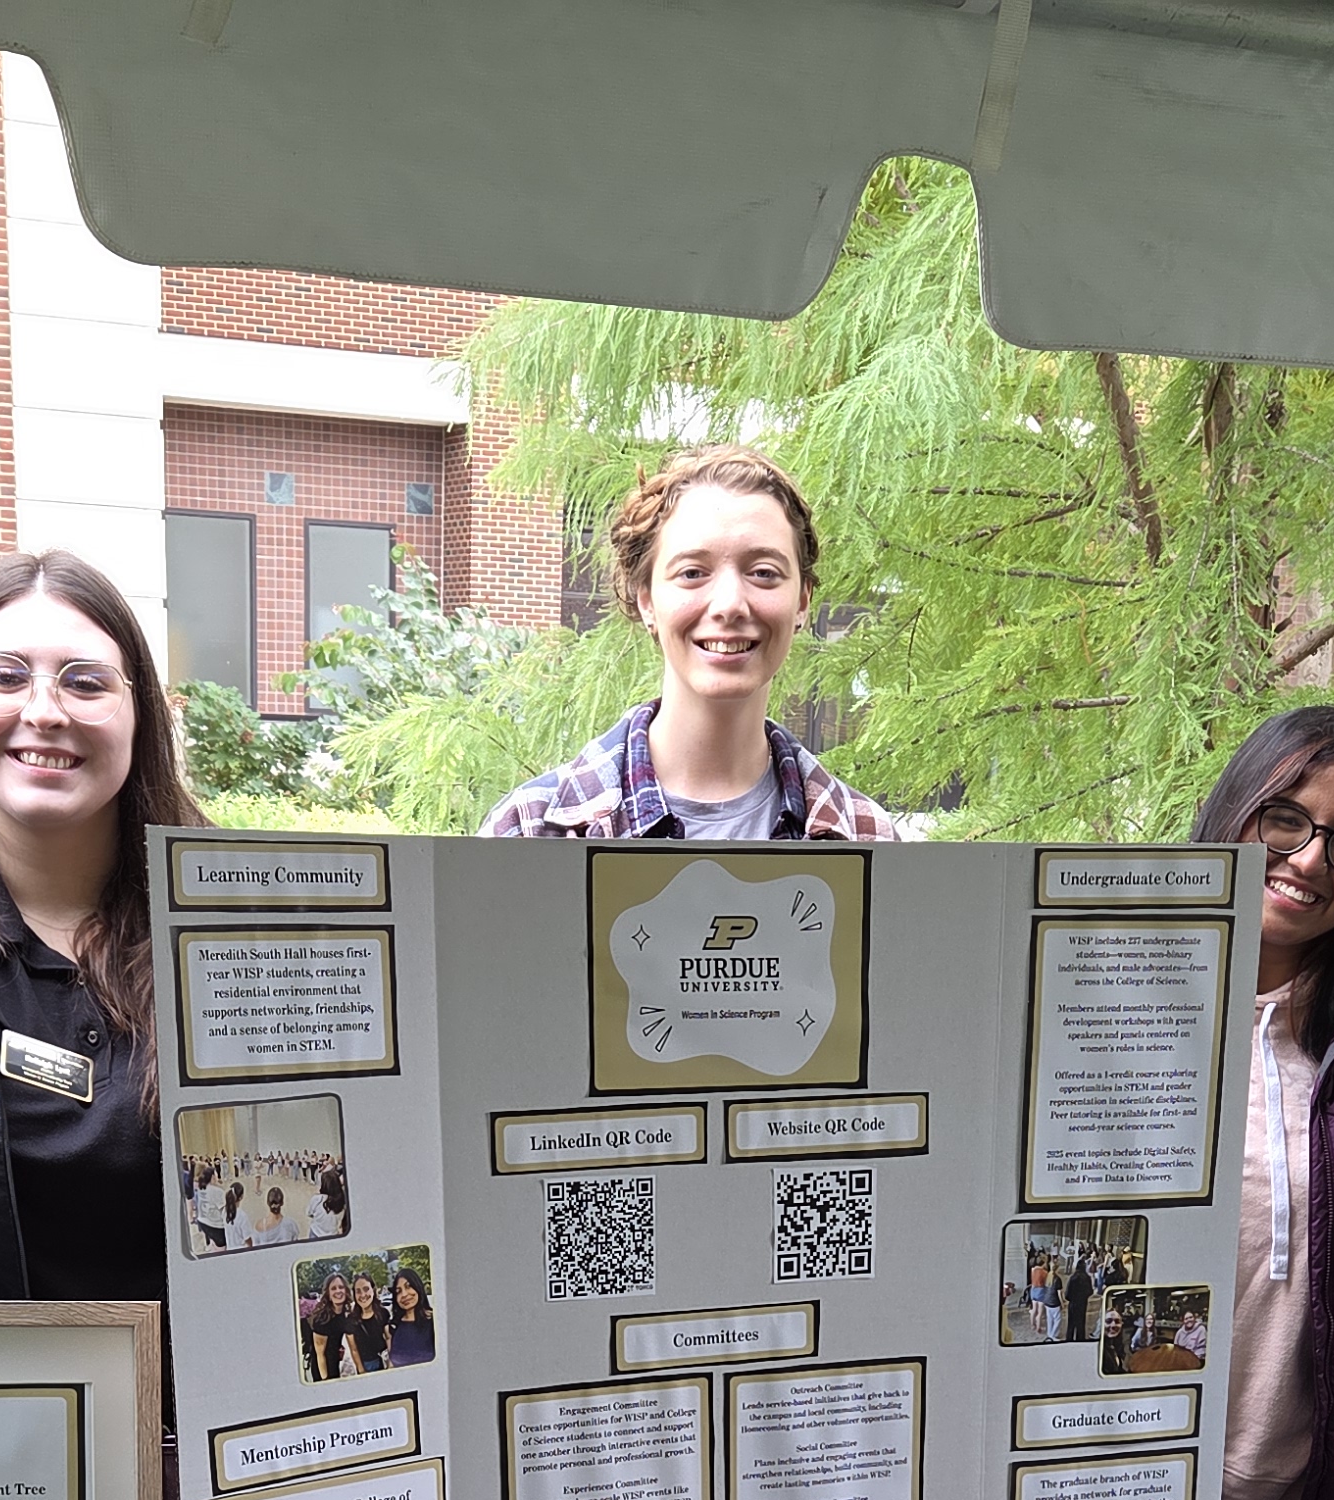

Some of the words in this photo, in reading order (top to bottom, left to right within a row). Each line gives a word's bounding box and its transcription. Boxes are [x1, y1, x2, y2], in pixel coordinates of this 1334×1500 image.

[197, 866, 270, 886] Learning
[275, 867, 363, 887] Community
[1060, 872, 1161, 887] Undergraduate
[1165, 871, 1210, 885] Cohort
[703, 916, 758, 950] P
[1069, 937, 1093, 945] WISP
[1095, 937, 1126, 945] includes
[1143, 937, 1201, 946] undergraduate
[199, 949, 247, 961] Meredith
[250, 949, 281, 960] South
[284, 948, 307, 959] Hall
[310, 948, 344, 959] houses
[346, 947, 371, 958] first-
[207, 969, 229, 982] year
[233, 968, 263, 978] WISP
[266, 968, 313, 979] students,
[316, 967, 356, 978] creating
[359, 968, 365, 976] a
[679, 958, 779, 979] PURDUE
[214, 987, 270, 998] residential
[273, 986, 338, 997] environment
[340, 984, 361, 994] that
[202, 1006, 248, 1020] supports
[251, 1005, 313, 1017] networking,
[316, 1003, 374, 1015] friendships,
[682, 1011, 708, 1019] Women
[719, 1010, 747, 1018] Science
[749, 1010, 780, 1020] Program
[209, 1025, 228, 1037] and
[230, 1027, 237, 1035] a
[239, 1025, 268, 1035] sense
[270, 1024, 281, 1034] of
[283, 1022, 333, 1034] belonging
[336, 1021, 370, 1032] among
[247, 1043, 284, 1054] women
[287, 1042, 297, 1052] in
[299, 1040, 335, 1051] STEM.
[767, 1121, 821, 1136] Website
[825, 1119, 847, 1134] QR
[851, 1117, 885, 1132] Code
[530, 1133, 601, 1150] LinkedIn
[606, 1131, 631, 1148] QR
[635, 1129, 672, 1144] Code
[673, 1328, 759, 1348] Committees
[559, 1405, 611, 1417] Engagement
[613, 1400, 658, 1411] Committee
[1052, 1413, 1114, 1428] Graduate
[1117, 1409, 1162, 1424] Cohort
[241, 1437, 326, 1466] Mentorship
[330, 1426, 393, 1451] Program
[1041, 1480, 1057, 1489] The
[1059, 1476, 1098, 1489] graduate
[1100, 1474, 1130, 1484] branch
[1132, 1472, 1142, 1481] of
[1143, 1470, 1169, 1479] WISP
[14, 1484, 46, 1495] Tree
[1080, 1489, 1117, 1500] network
[1119, 1488, 1131, 1497] for
[1133, 1484, 1172, 1496] graduate
